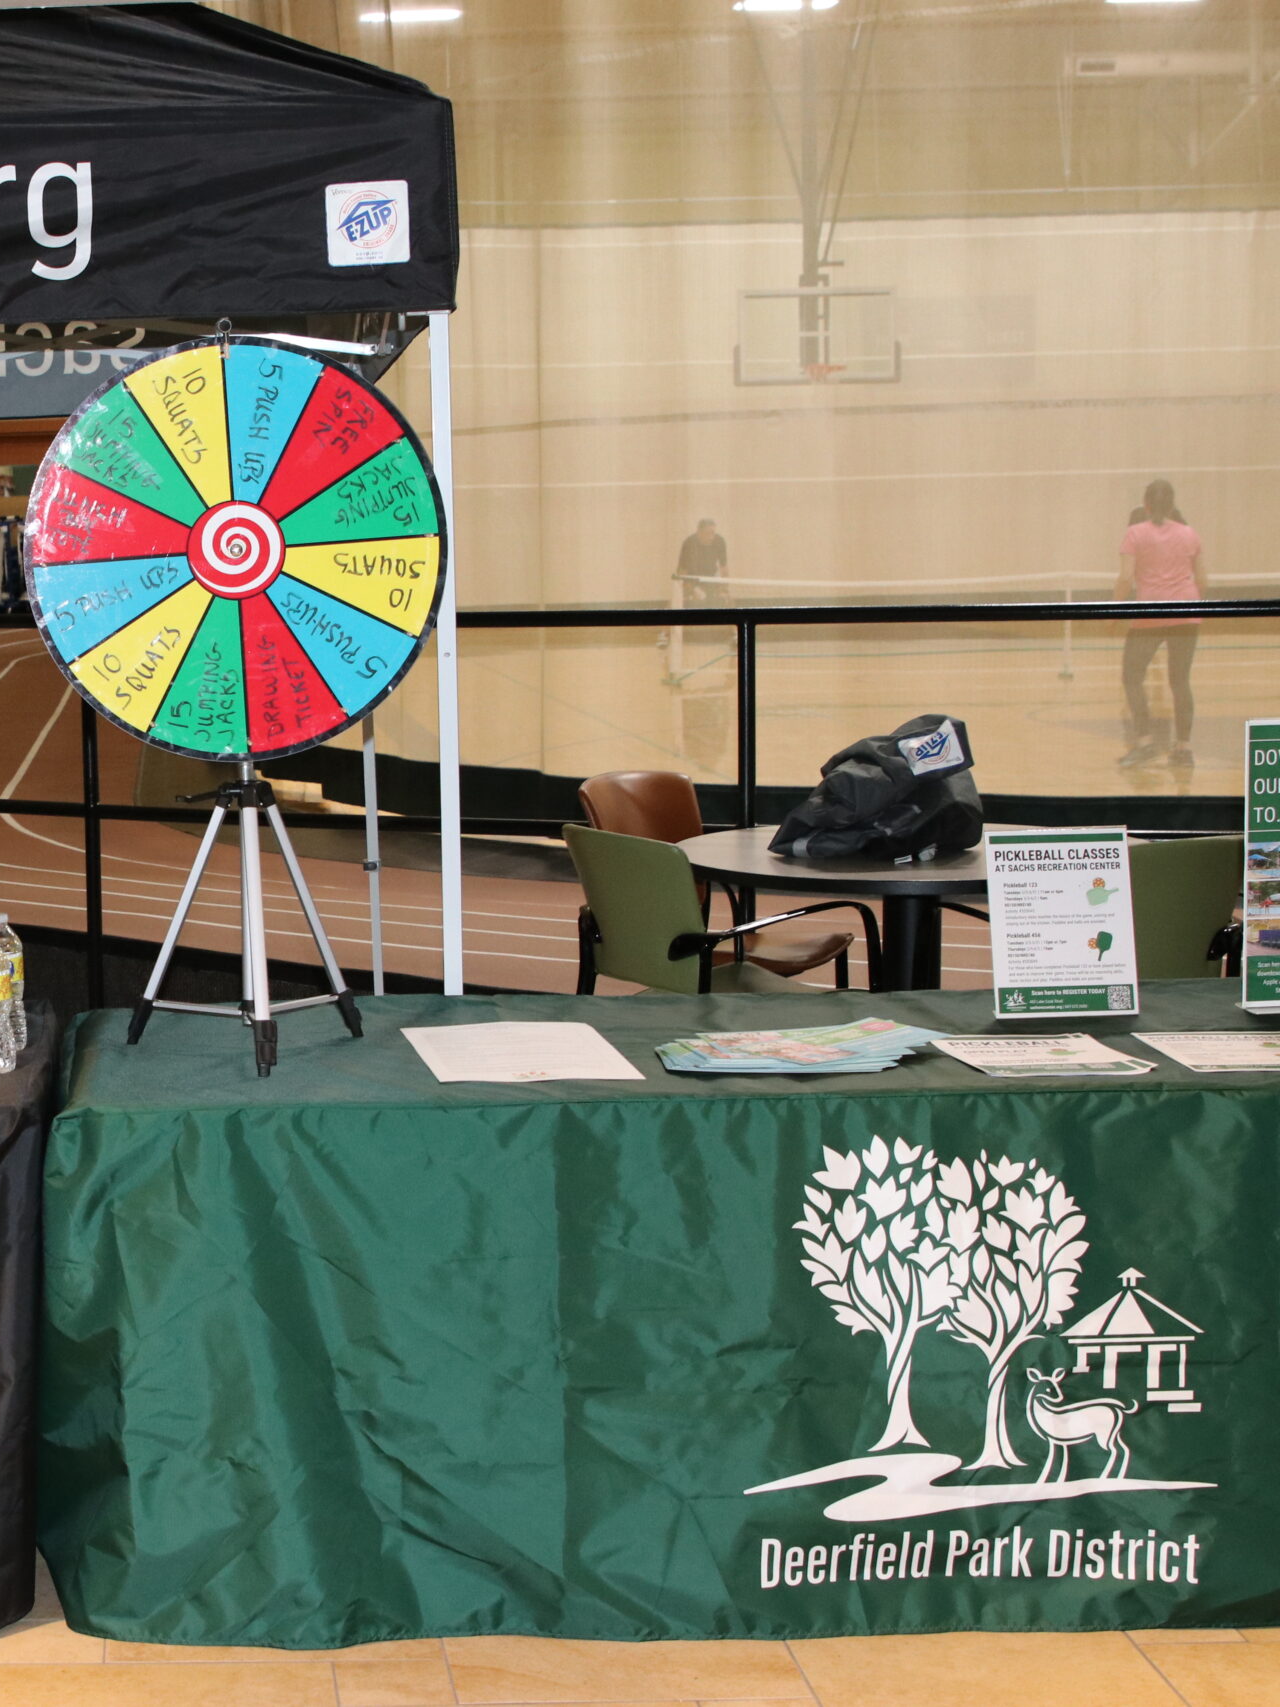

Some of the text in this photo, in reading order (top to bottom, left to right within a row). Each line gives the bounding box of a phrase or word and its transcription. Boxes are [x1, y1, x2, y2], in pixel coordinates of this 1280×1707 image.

[182, 368, 206, 395] 10
[108, 408, 137, 439] 15
[152, 376, 208, 464] SQUATS
[238, 358, 283, 484] 5 PUSH UPS
[312, 386, 353, 448] SPIN
[330, 400, 375, 454] FREE
[336, 455, 403, 503] JACKS
[393, 502, 420, 527] 15
[333, 553, 426, 579] SQUATS
[54, 600, 75, 633] 5
[75, 580, 133, 616] PUSH
[389, 588, 413, 612] 10
[93, 653, 121, 681] 10
[115, 625, 181, 710] SQUATS
[194, 642, 222, 742] JUMPING
[257, 635, 285, 737] DRAWING
[355, 655, 388, 679] 5
[167, 701, 192, 728] 15
[215, 669, 240, 746] JACKS
[282, 658, 312, 729] TICKET
[994, 847, 1120, 862] PICKLEBALL CLASSES
[995, 861, 1120, 872] AT SACHS RECREATION CENTER
[760, 1526, 1200, 1589] Deerfield Park District
